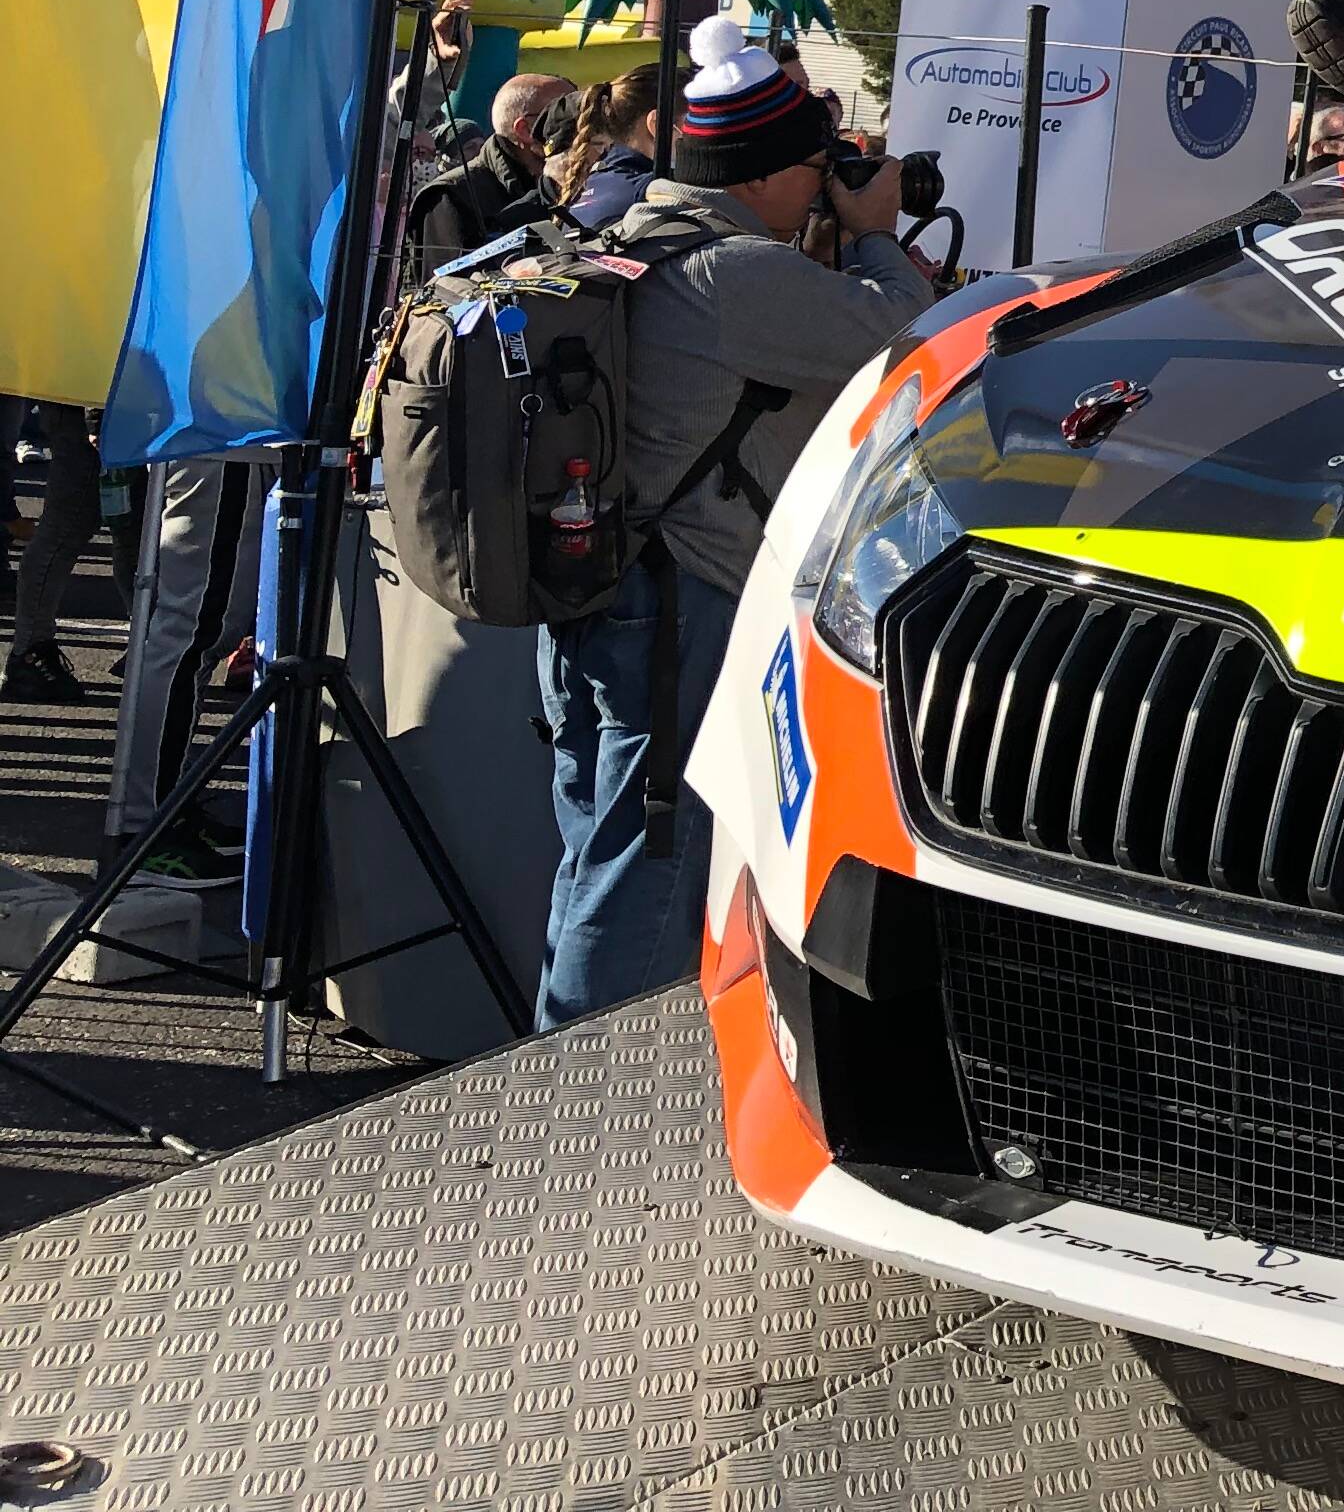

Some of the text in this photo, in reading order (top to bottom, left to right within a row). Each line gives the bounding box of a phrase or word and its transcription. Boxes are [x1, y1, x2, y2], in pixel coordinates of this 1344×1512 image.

[920, 62, 1092, 94] Automobil Club
[947, 106, 1062, 134] De Provce
[1015, 1221, 1338, 1306] Transports
